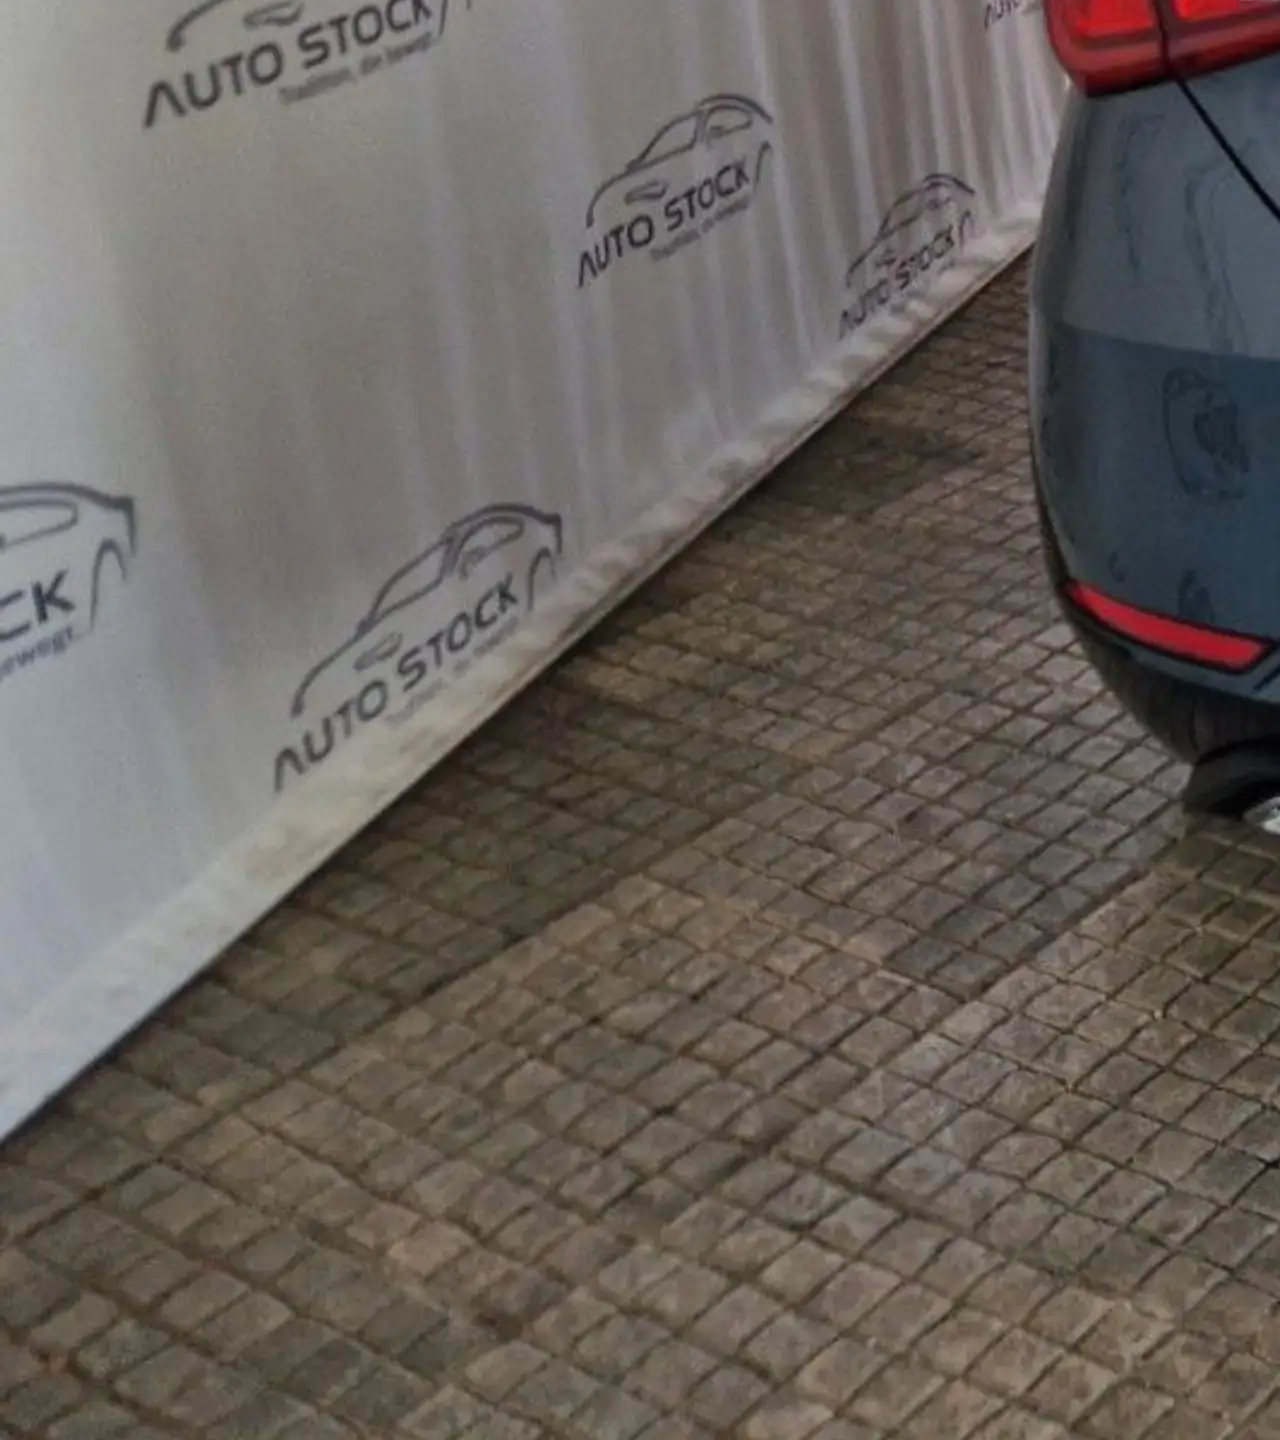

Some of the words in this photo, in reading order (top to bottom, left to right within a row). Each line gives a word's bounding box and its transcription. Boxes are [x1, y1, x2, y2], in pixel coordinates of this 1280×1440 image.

[143, 42, 284, 129] AUTO
[578, 214, 655, 289] AUTO
[664, 159, 751, 232] STOCK
[273, 678, 389, 793] AUTO
[396, 571, 519, 693] STOCK
